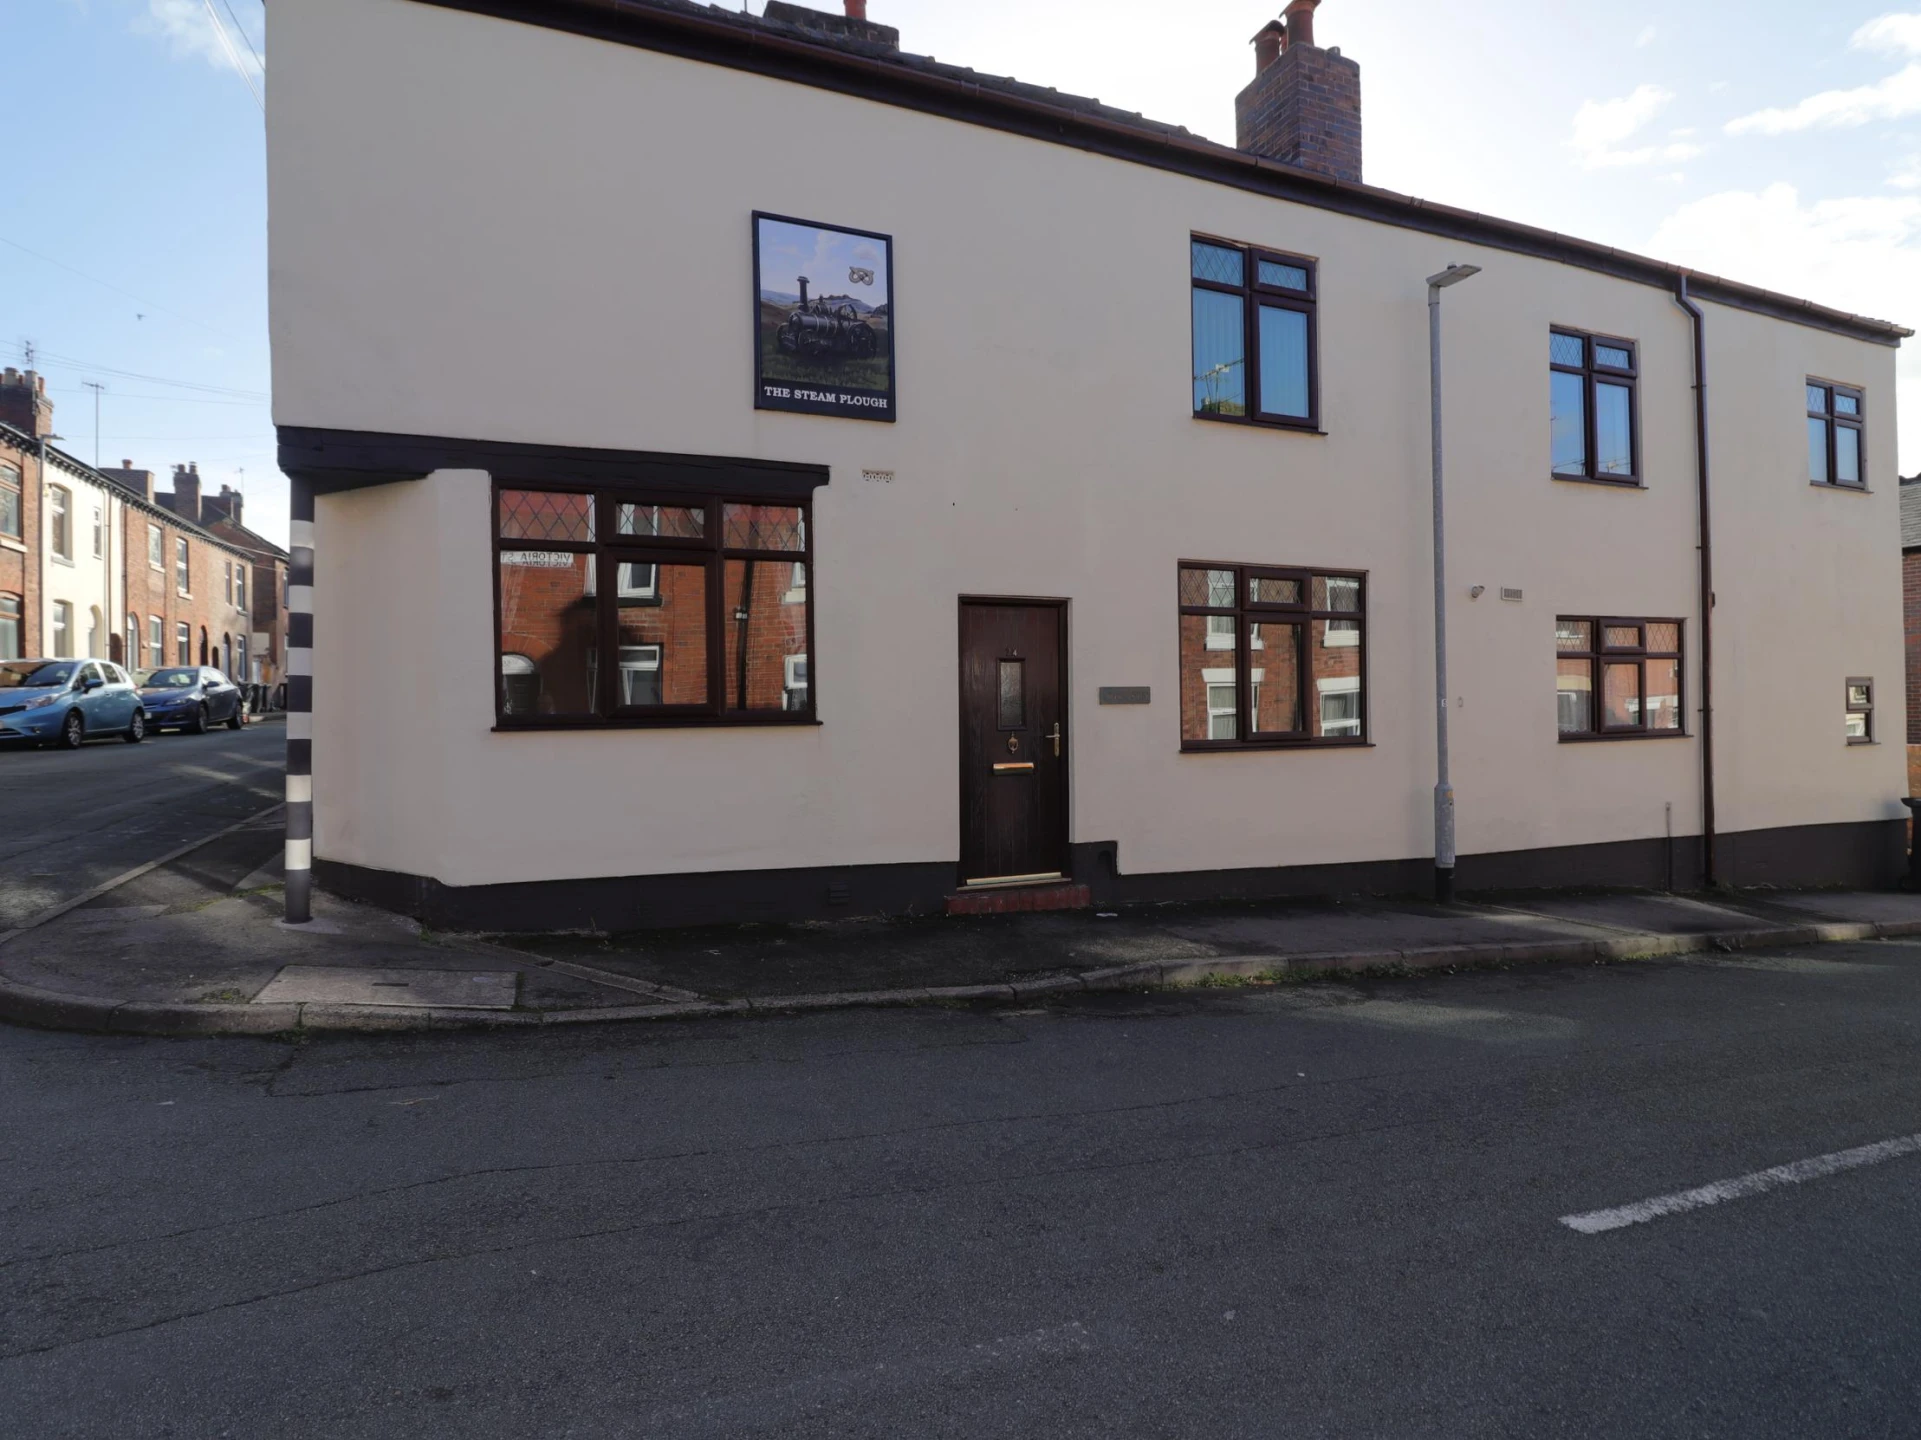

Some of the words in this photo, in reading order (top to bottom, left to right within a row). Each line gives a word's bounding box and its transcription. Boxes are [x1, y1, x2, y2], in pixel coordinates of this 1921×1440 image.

[764, 386, 790, 398] THE
[794, 389, 836, 403] STEAM
[839, 394, 888, 408] PLOUGH
